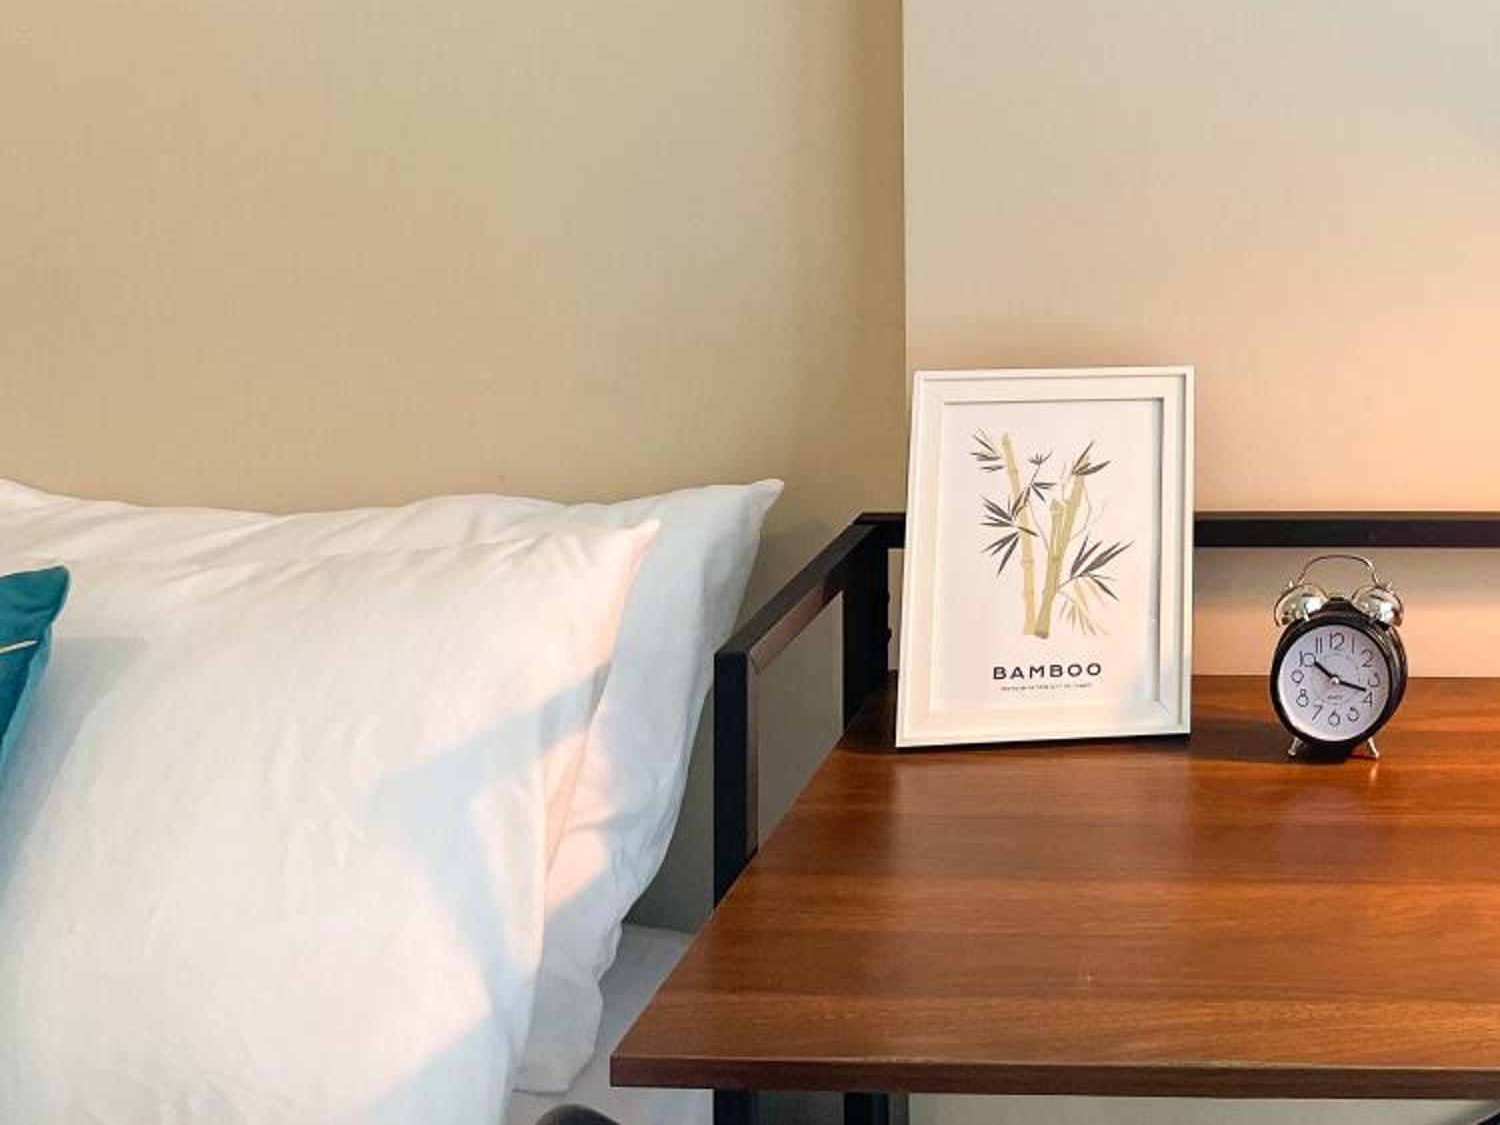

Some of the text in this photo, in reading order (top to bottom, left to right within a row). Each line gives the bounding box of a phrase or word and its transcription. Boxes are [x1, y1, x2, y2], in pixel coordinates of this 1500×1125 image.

[1315, 637, 1323, 654] 11
[1329, 632, 1345, 651] 12
[1299, 651, 1316, 668] 10
[1361, 649, 1373, 667] 2
[993, 663, 1102, 680] BAMBOO
[1291, 670, 1304, 687] 9
[1368, 672, 1381, 688] 3
[1296, 689, 1309, 707] 8
[1363, 691, 1373, 707] 4
[1311, 705, 1323, 720] 7
[1328, 709, 1341, 727] 6
[1347, 706, 1360, 722] 5
